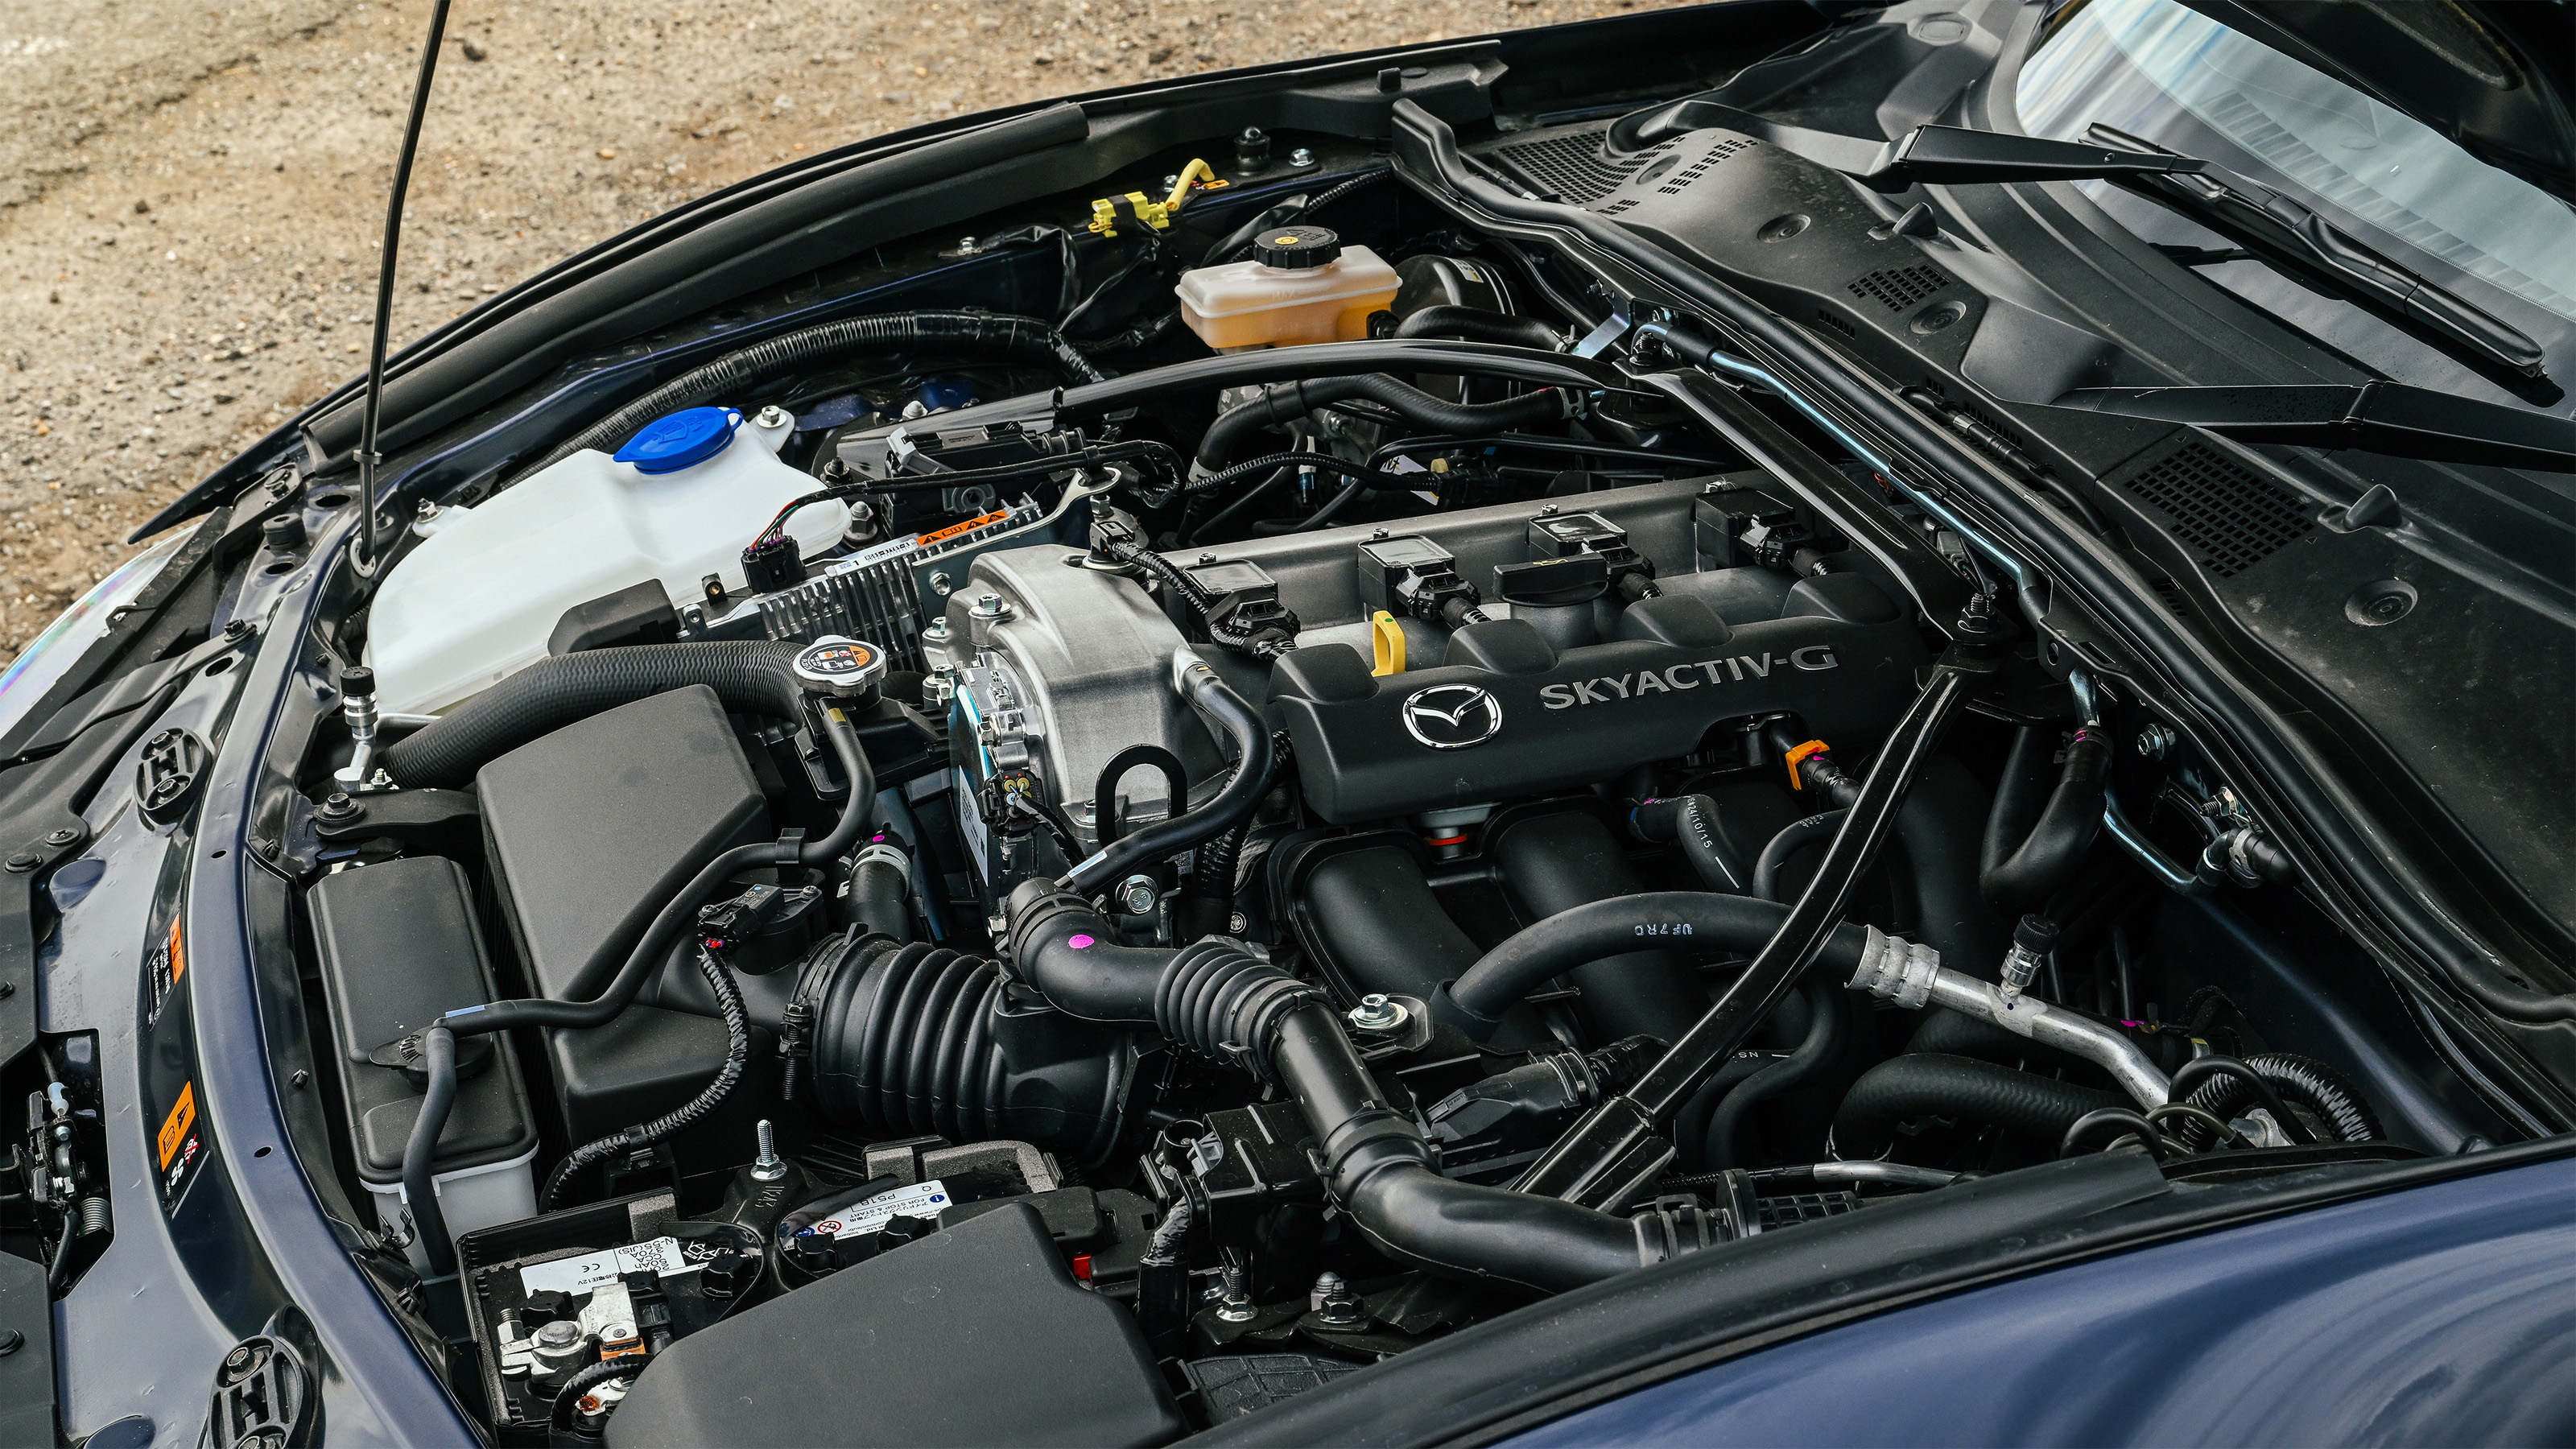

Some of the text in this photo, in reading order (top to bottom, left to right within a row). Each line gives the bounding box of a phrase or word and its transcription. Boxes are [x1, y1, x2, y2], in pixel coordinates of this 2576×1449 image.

[1539, 645, 1839, 710] SKYACTIV-G
[860, 1193, 896, 1206] P51B
[885, 1202, 906, 1210] STOP
[849, 1209, 875, 1218] START
[618, 1237, 674, 1255] N-55(JIS)
[630, 1247, 664, 1258] 370A
[636, 1253, 663, 1263] CCA
